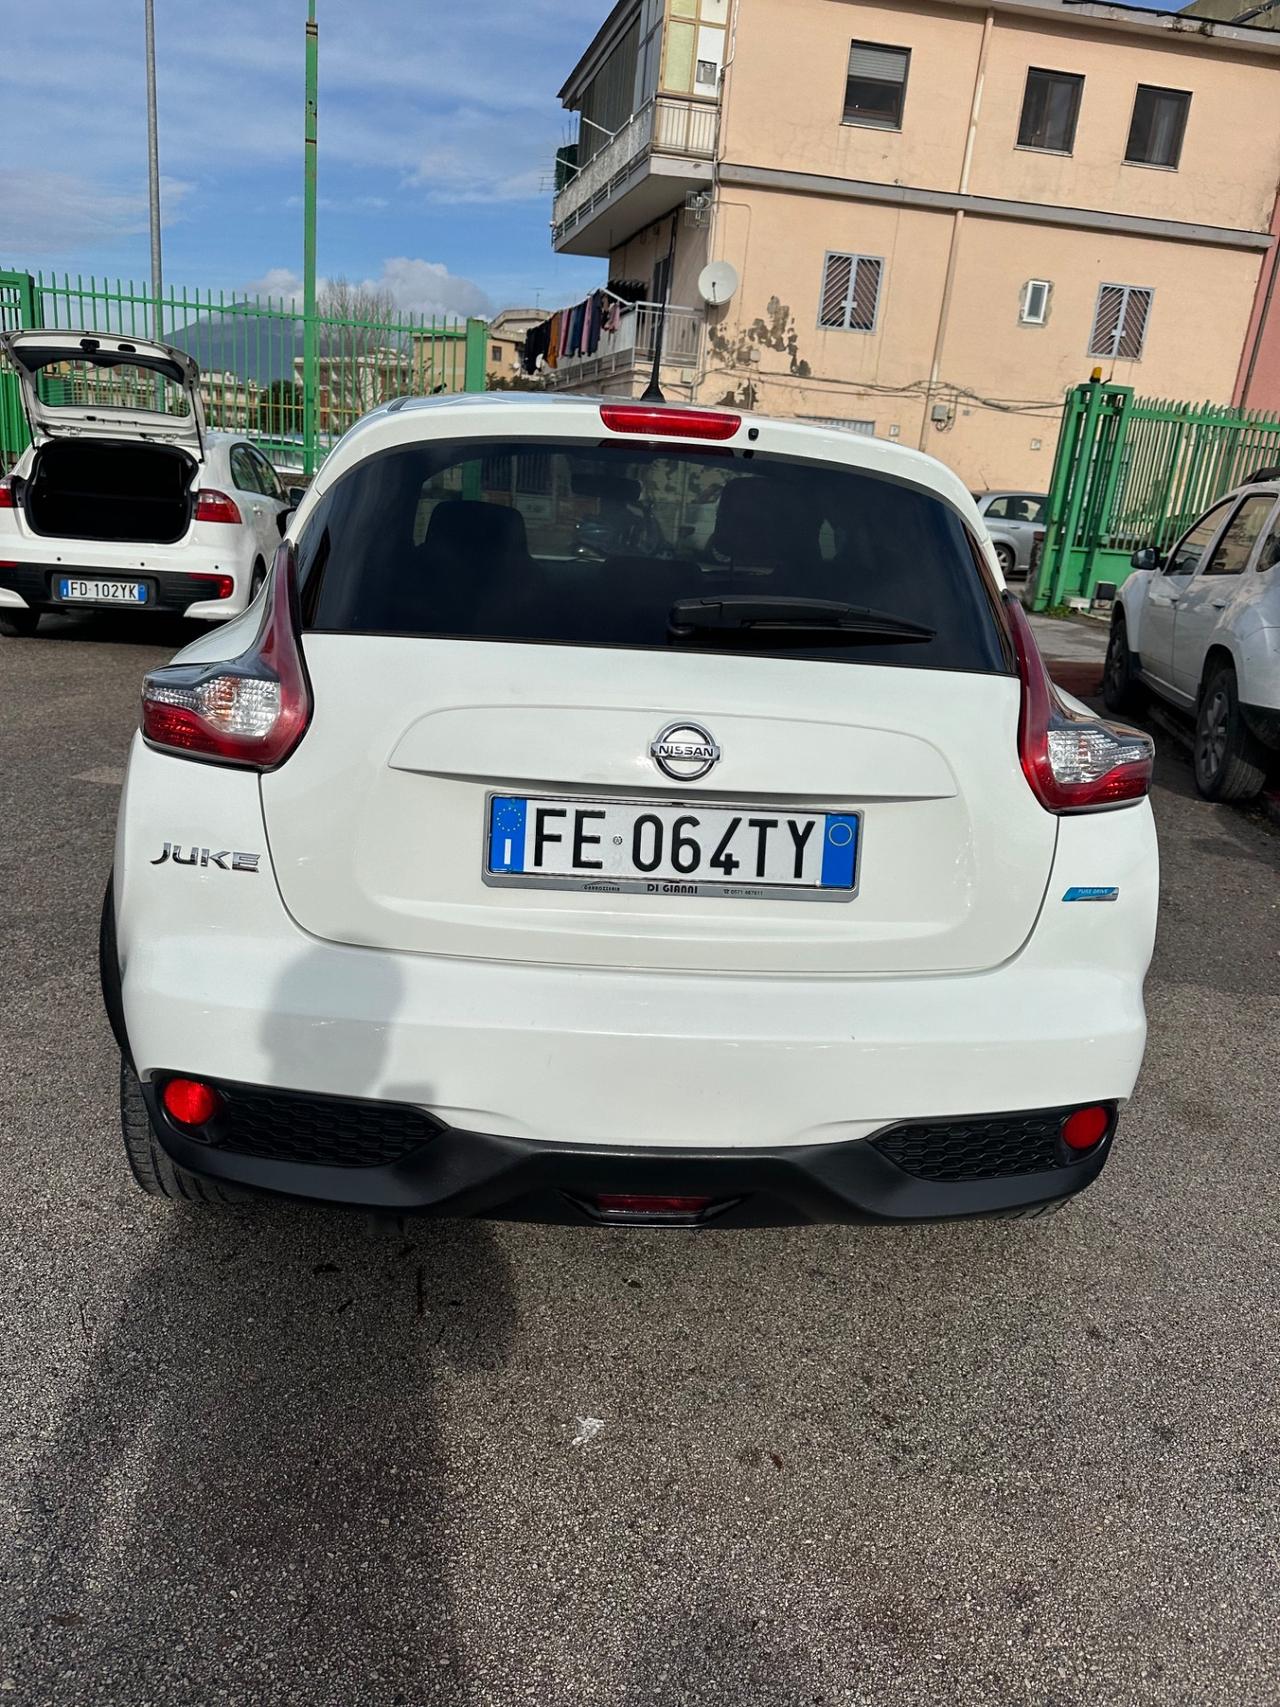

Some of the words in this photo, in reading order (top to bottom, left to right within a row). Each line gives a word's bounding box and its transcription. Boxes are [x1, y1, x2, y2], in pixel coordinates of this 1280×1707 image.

[70, 581, 88, 596] FD
[94, 583, 137, 599] 102YK
[658, 745, 714, 757] NISSAN
[503, 838, 512, 865] I
[533, 807, 606, 870] FE
[632, 813, 816, 879] 064TY
[150, 842, 261, 873] JUKE
[647, 883, 659, 892] DI
[662, 884, 698, 894] GIANNI
